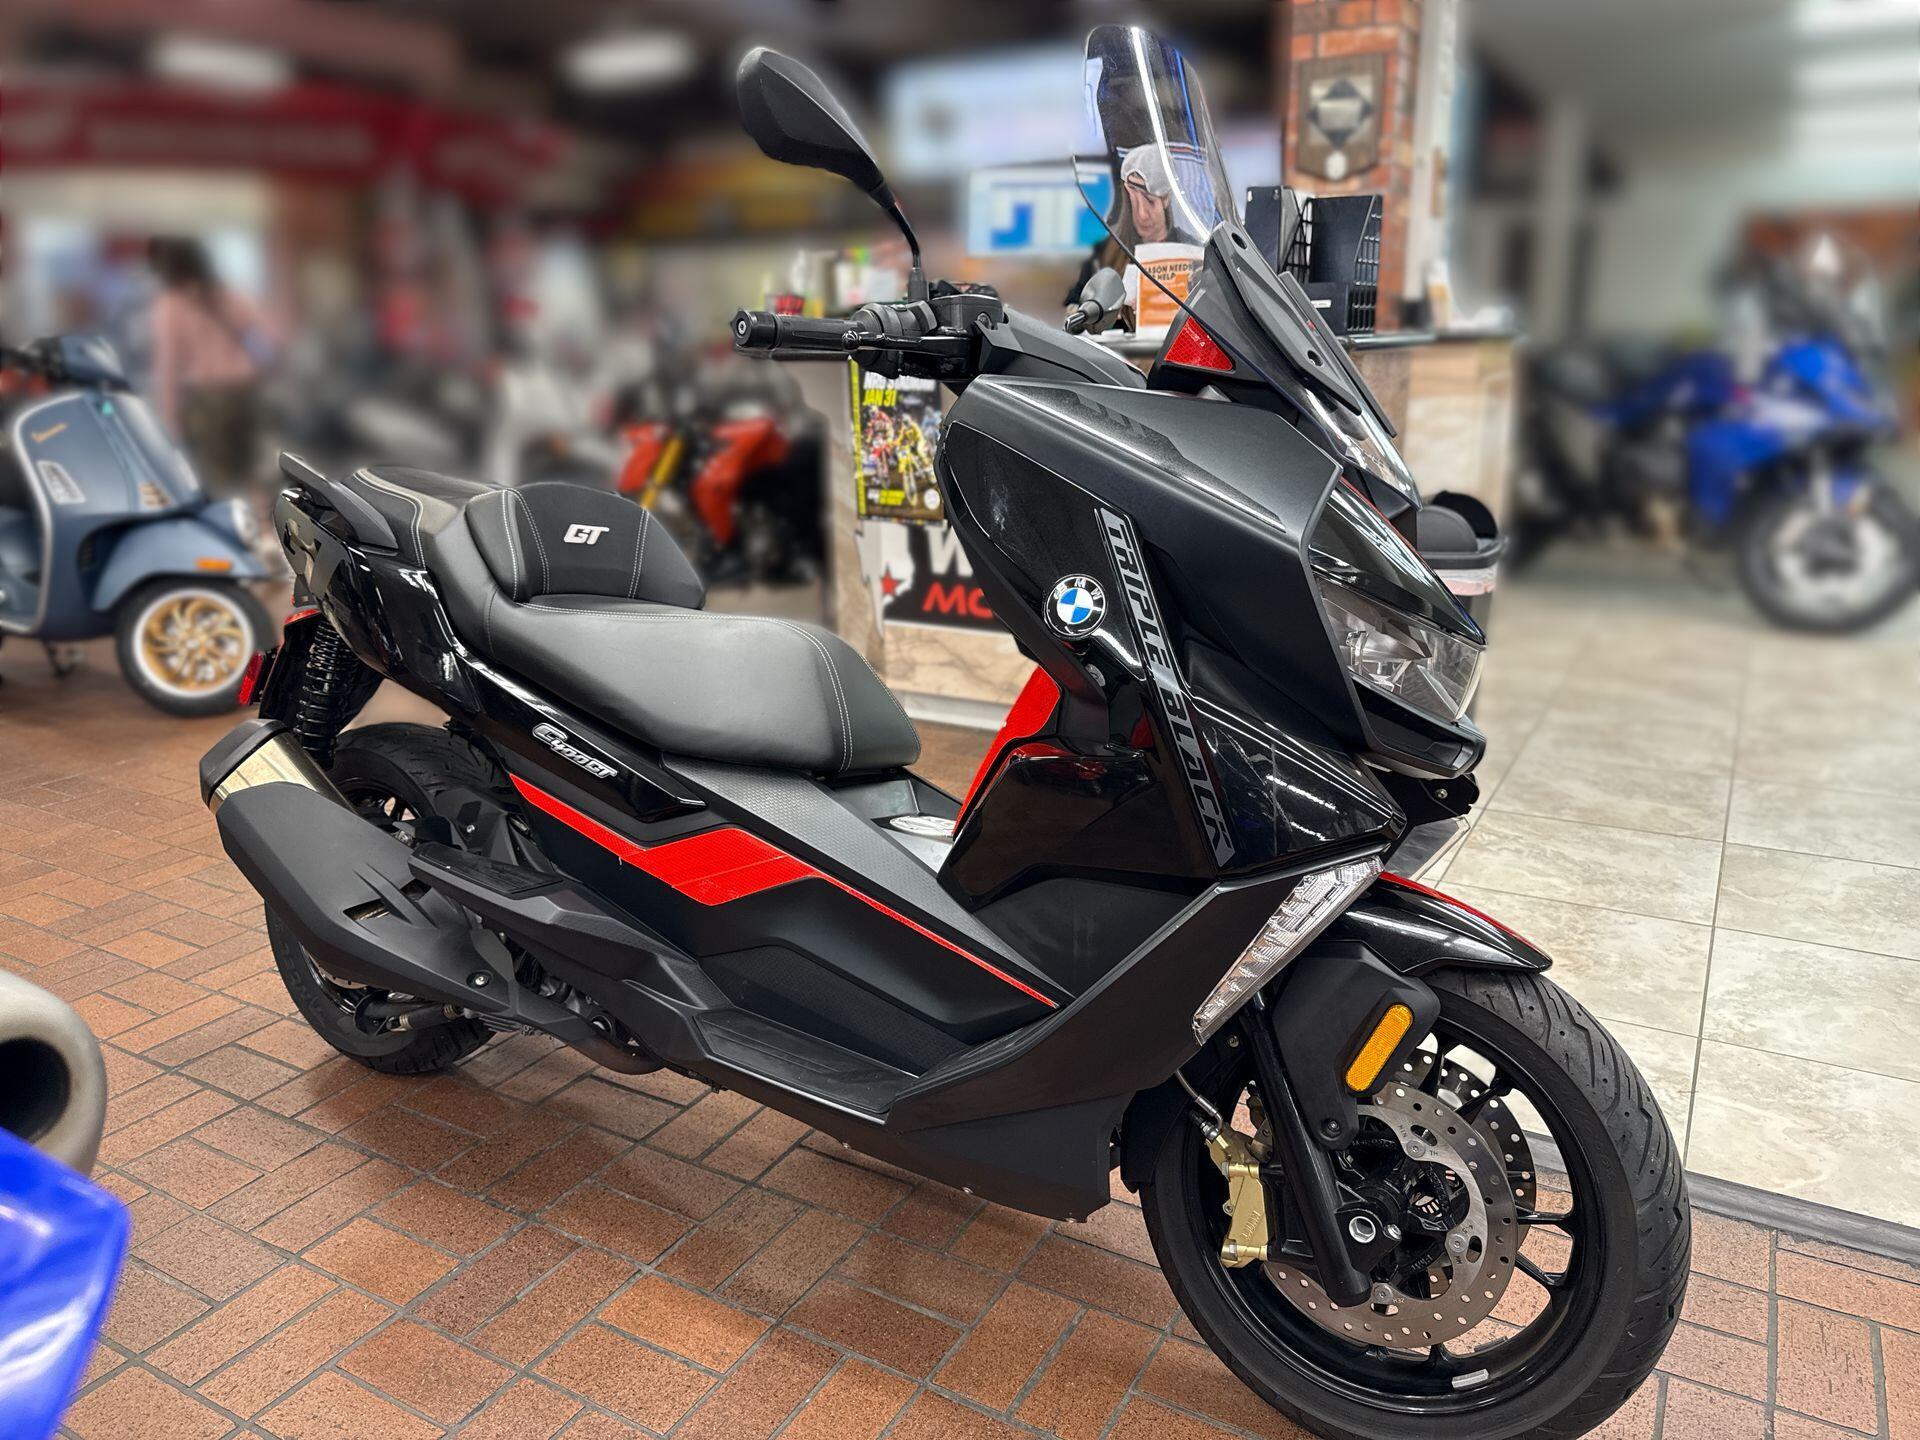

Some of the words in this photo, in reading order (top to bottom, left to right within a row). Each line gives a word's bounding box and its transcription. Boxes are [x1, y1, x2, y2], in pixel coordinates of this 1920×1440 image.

[862, 388, 884, 407] JAN
[883, 389, 897, 407] 31
[564, 524, 610, 545] GT
[1053, 577, 1104, 600] BMW
[1108, 523, 1172, 670] TRIPLE
[1165, 693, 1232, 852] BLACK
